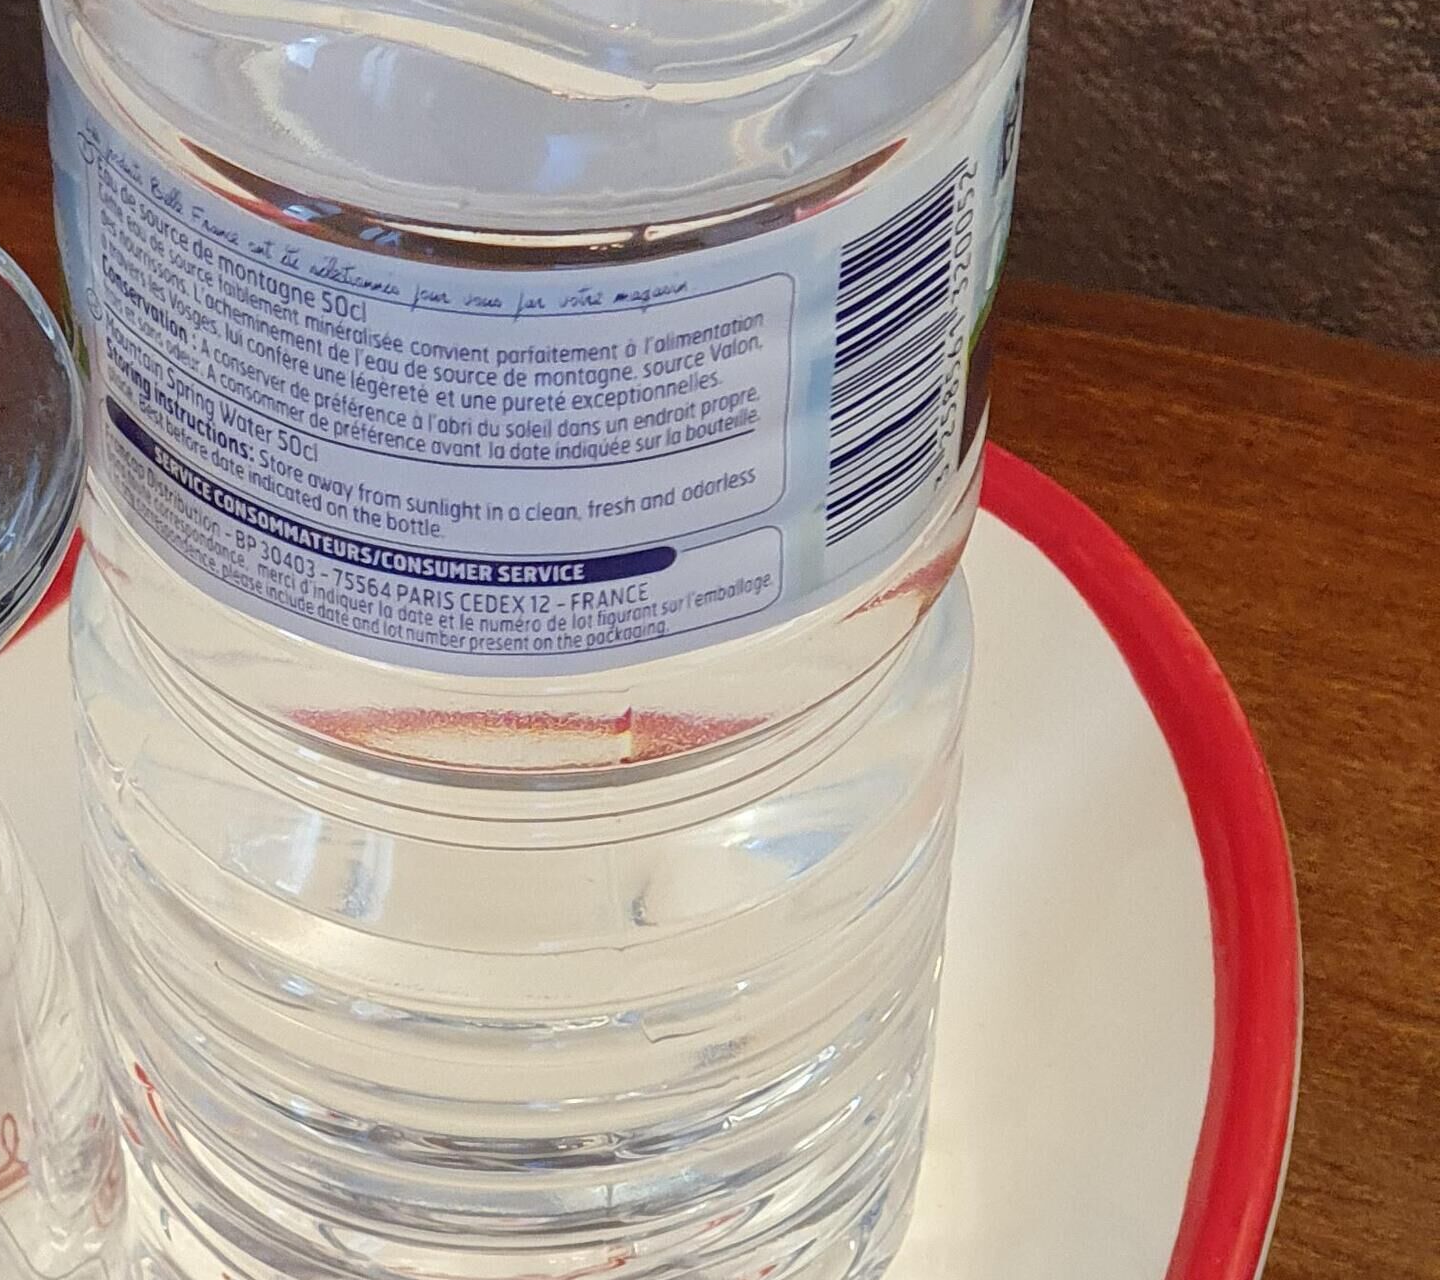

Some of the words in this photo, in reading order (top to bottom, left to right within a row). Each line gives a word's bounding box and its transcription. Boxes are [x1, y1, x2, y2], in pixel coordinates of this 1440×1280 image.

[120, 186, 136, 212] de
[139, 203, 188, 251] source
[192, 239, 212, 265] de
[218, 255, 315, 307] montagne
[322, 290, 366, 322] 50cl
[126, 215, 146, 242] eau
[149, 235, 164, 257] de
[169, 249, 212, 287] source
[218, 274, 298, 324] faiblement
[305, 315, 402, 352] minéralisée
[410, 341, 488, 363] convient
[496, 344, 617, 366] parfaitement
[645, 313, 763, 353] l'alimentation
[191, 206, 239, 246] France
[410, 283, 451, 312] pour
[512, 290, 546, 323] par
[951, 160, 978, 305] 320052
[102, 254, 187, 342] Conservation
[201, 338, 209, 356] A
[213, 348, 285, 392] conserver
[290, 381, 309, 402] de
[314, 391, 406, 427] préférence
[428, 414, 472, 435] l'abri
[477, 420, 499, 437] du
[505, 420, 551, 438] soleil
[557, 419, 600, 437] dans
[605, 417, 627, 433] un
[633, 403, 695, 429] endroit
[106, 312, 163, 383] Mountain
[166, 367, 214, 423] Spring
[219, 401, 272, 442] Water
[277, 428, 317, 461] 50cl
[148, 275, 165, 302] les
[225, 322, 242, 346] lui
[247, 338, 308, 375] confère
[313, 364, 345, 387] une
[350, 370, 428, 403] légèreté
[460, 393, 496, 410] une
[502, 391, 565, 414] pureté
[193, 285, 321, 355] L'acheminement
[328, 343, 349, 364] de
[355, 347, 398, 375] l'eau
[404, 359, 427, 379] de
[433, 366, 497, 386] source
[503, 368, 527, 387] de
[643, 351, 704, 378] source
[939, 315, 965, 439] 258561
[106, 336, 151, 400] Storing
[154, 382, 253, 460] instructions:
[259, 448, 303, 483] Store
[308, 473, 353, 501] away
[358, 483, 400, 508] from
[406, 497, 481, 522] sunlight
[486, 505, 503, 520] in
[508, 506, 519, 521] a
[587, 496, 635, 517] fresh
[640, 488, 675, 510] and
[166, 415, 207, 459] before
[211, 449, 244, 479] date
[248, 471, 322, 511] indicated
[326, 501, 347, 517] on
[353, 506, 381, 527] the
[207, 363, 216, 382] A
[220, 373, 304, 421] consommer
[309, 412, 328, 431] de
[333, 420, 425, 452] préférence
[431, 440, 480, 457] avant
[489, 441, 504, 459] la
[510, 443, 550, 460] date
[555, 437, 630, 459] indiquée
[635, 434, 661, 452] sur
[666, 430, 681, 445] la
[154, 445, 210, 500] SERVICE
[214, 490, 491, 580] CONSOMMATEURS/CONSUMER
[498, 564, 583, 582] SERVICE
[235, 529, 256, 549] BP
[260, 540, 315, 578] 30403
[333, 567, 390, 597] 75564
[396, 583, 454, 610] PARIS
[459, 592, 524, 614] CEDEX
[530, 594, 550, 613] 12
[570, 582, 648, 610] FRANCE
[257, 562, 295, 589] merci
[300, 578, 374, 614] d'indiquer
[379, 600, 392, 618] la
[398, 606, 433, 626] date
[459, 613, 474, 630] le
[479, 618, 541, 632] numéro
[546, 615, 566, 632] de
[597, 602, 657, 628] figurant
[660, 598, 684, 615] sur
[265, 586, 314, 614] include
[317, 603, 348, 626] date
[351, 616, 379, 634] and
[405, 627, 465, 648] number
[469, 636, 529, 654] present
[533, 637, 551, 650] on
[556, 633, 582, 650] the
